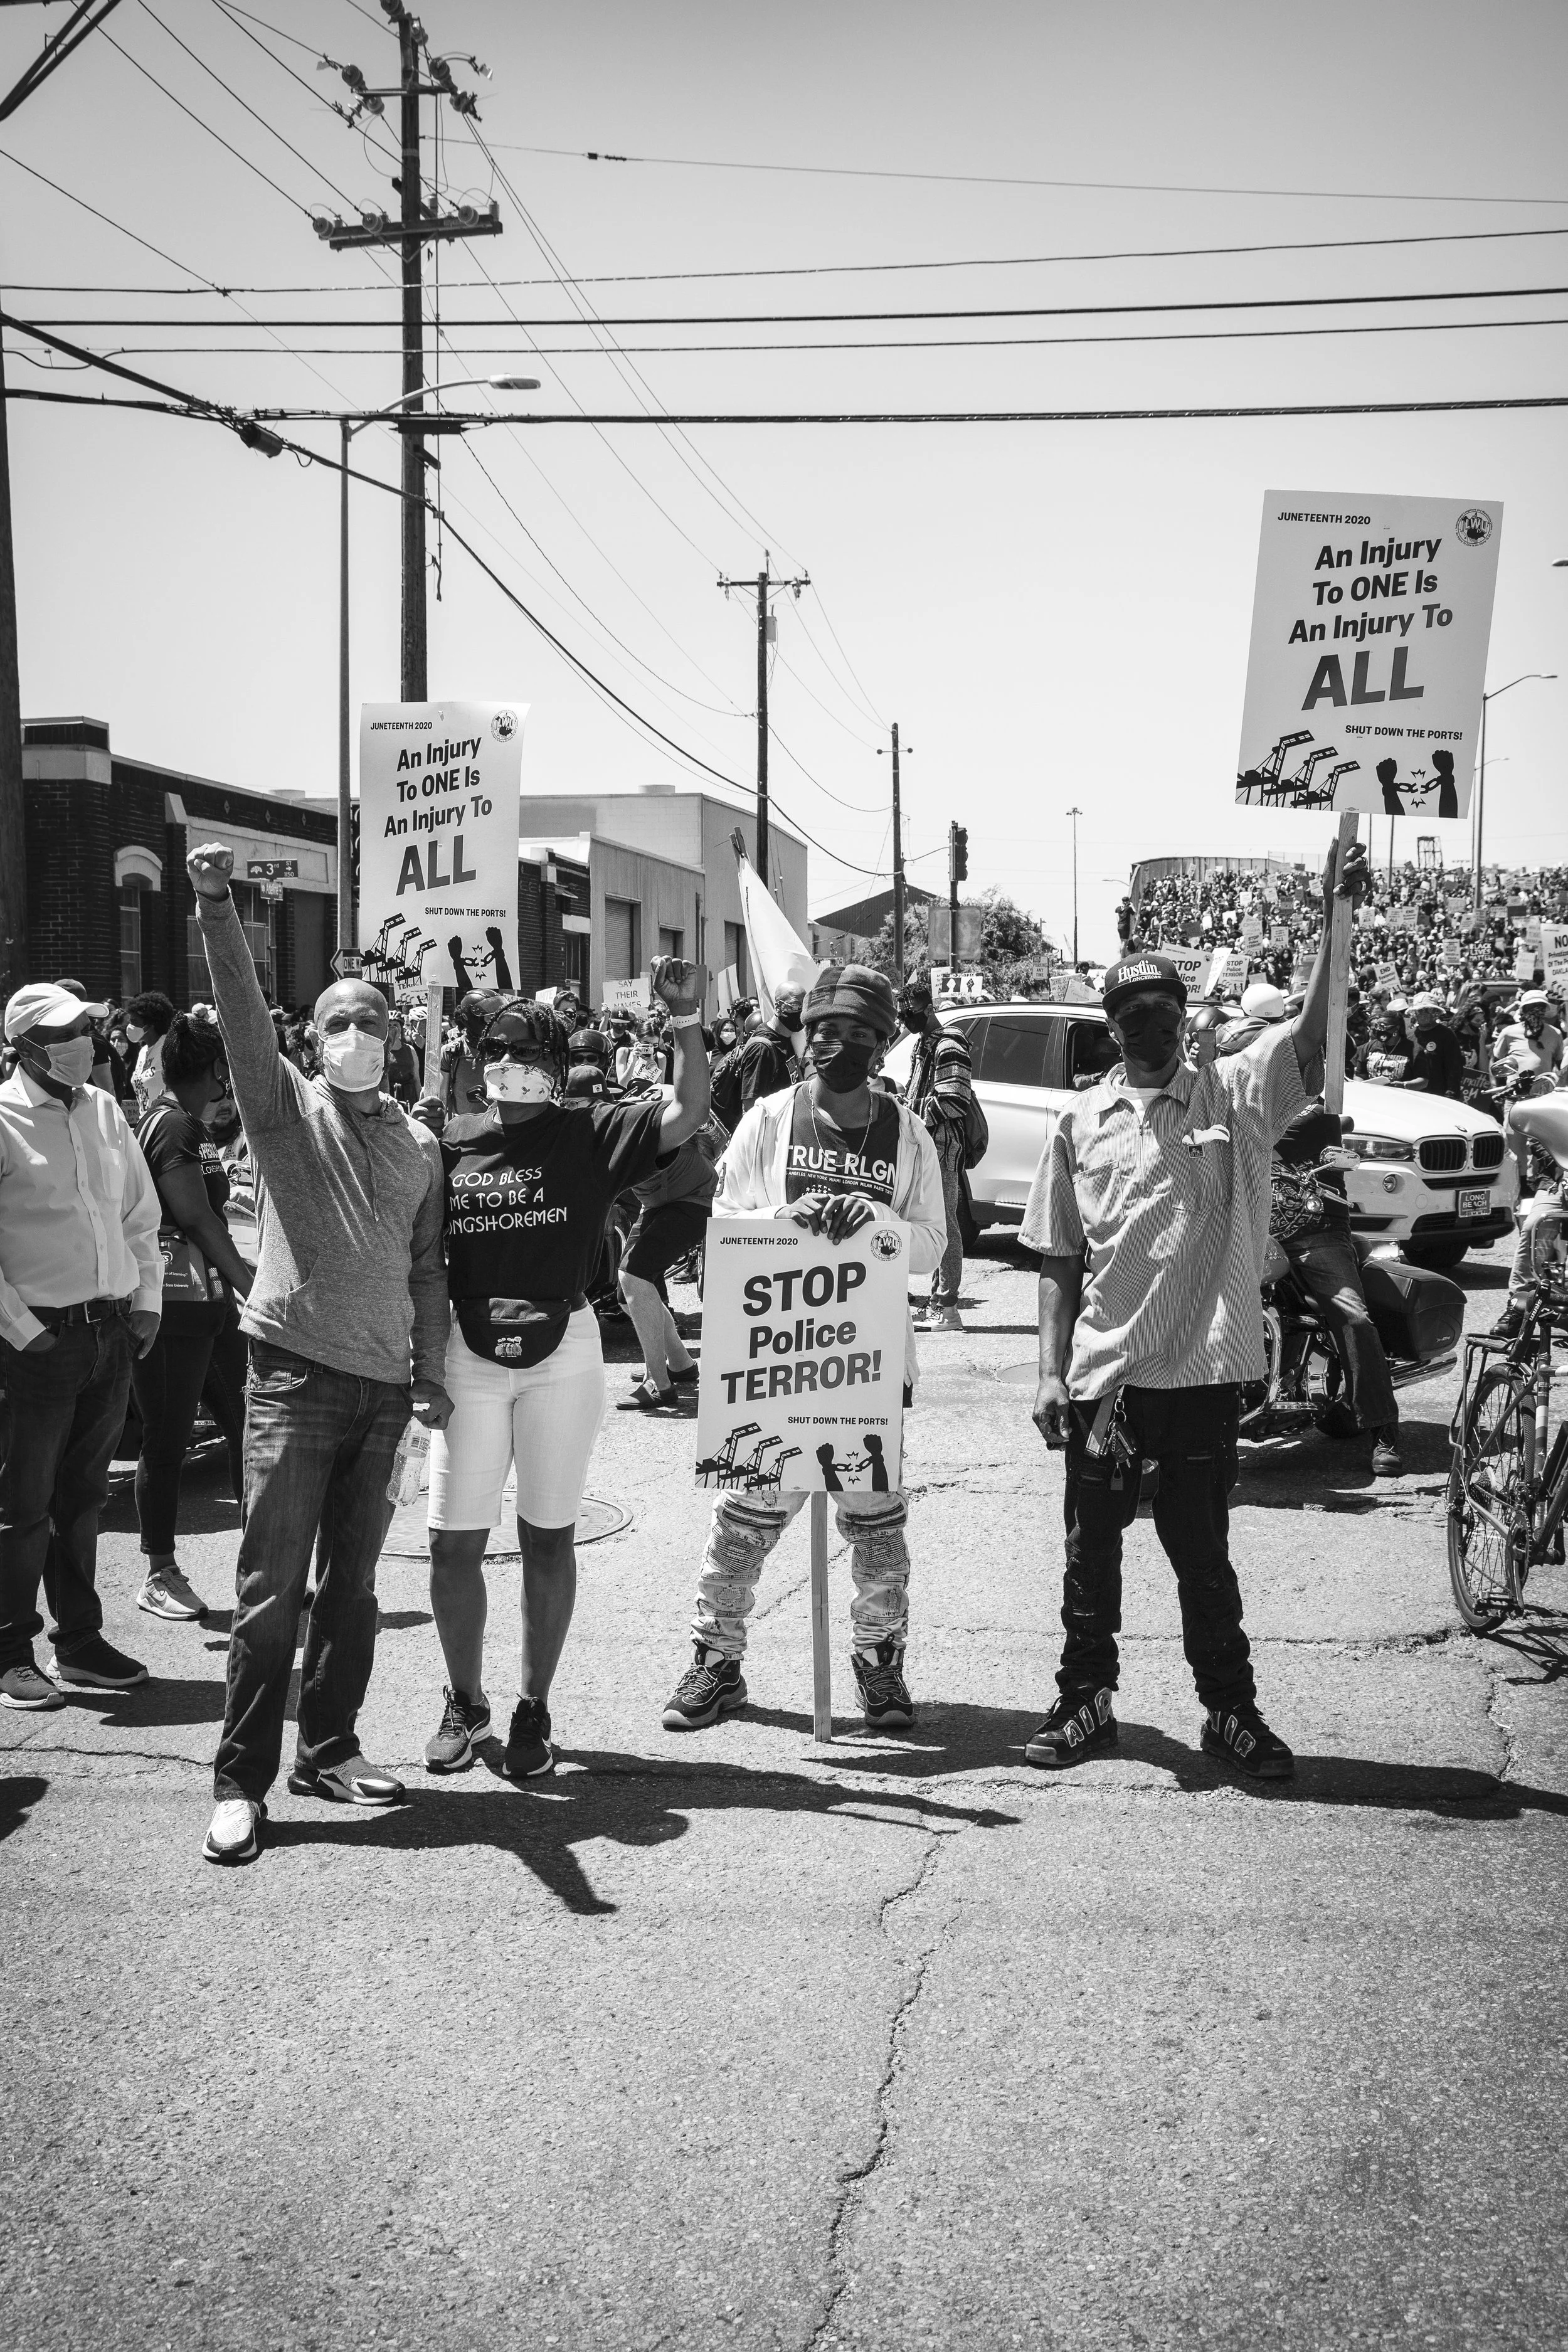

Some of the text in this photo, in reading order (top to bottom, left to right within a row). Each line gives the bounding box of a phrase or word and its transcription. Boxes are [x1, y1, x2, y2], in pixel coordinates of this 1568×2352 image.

[1278, 512, 1371, 525] JUNETEENTH 2020
[1315, 537, 1442, 570] An Injury
[1313, 569, 1438, 605] To ONE Is
[1288, 603, 1453, 644] An Injury To
[1301, 646, 1424, 711] ALL
[371, 722, 413, 730] JUNETEENTH
[1345, 724, 1463, 740] SHUT DOWN THE PORTS!
[396, 737, 482, 771] An Injury
[396, 766, 480, 803] To ONE Is
[384, 795, 492, 838] An Injury To
[266, 863, 279, 875] 3rd
[396, 834, 476, 896] ALL
[425, 906, 506, 918] SHUT DOWN THE PORTS!
[1555, 935, 1568, 948] NO
[344, 958, 354, 969] ONE
[1180, 973, 1196, 982] lice
[615, 990, 638, 999] THEIR
[1463, 1074, 1490, 1088] matte
[452, 1167, 542, 1187] GOD BLESS
[450, 1187, 544, 1211] ME TO BE A
[720, 1237, 775, 1245] JUNETEENTH
[743, 1261, 866, 1316] STOP
[749, 1318, 857, 1359] Police
[721, 1349, 882, 1404] TERROR!
[1064, 1687, 1113, 1748] AIR
